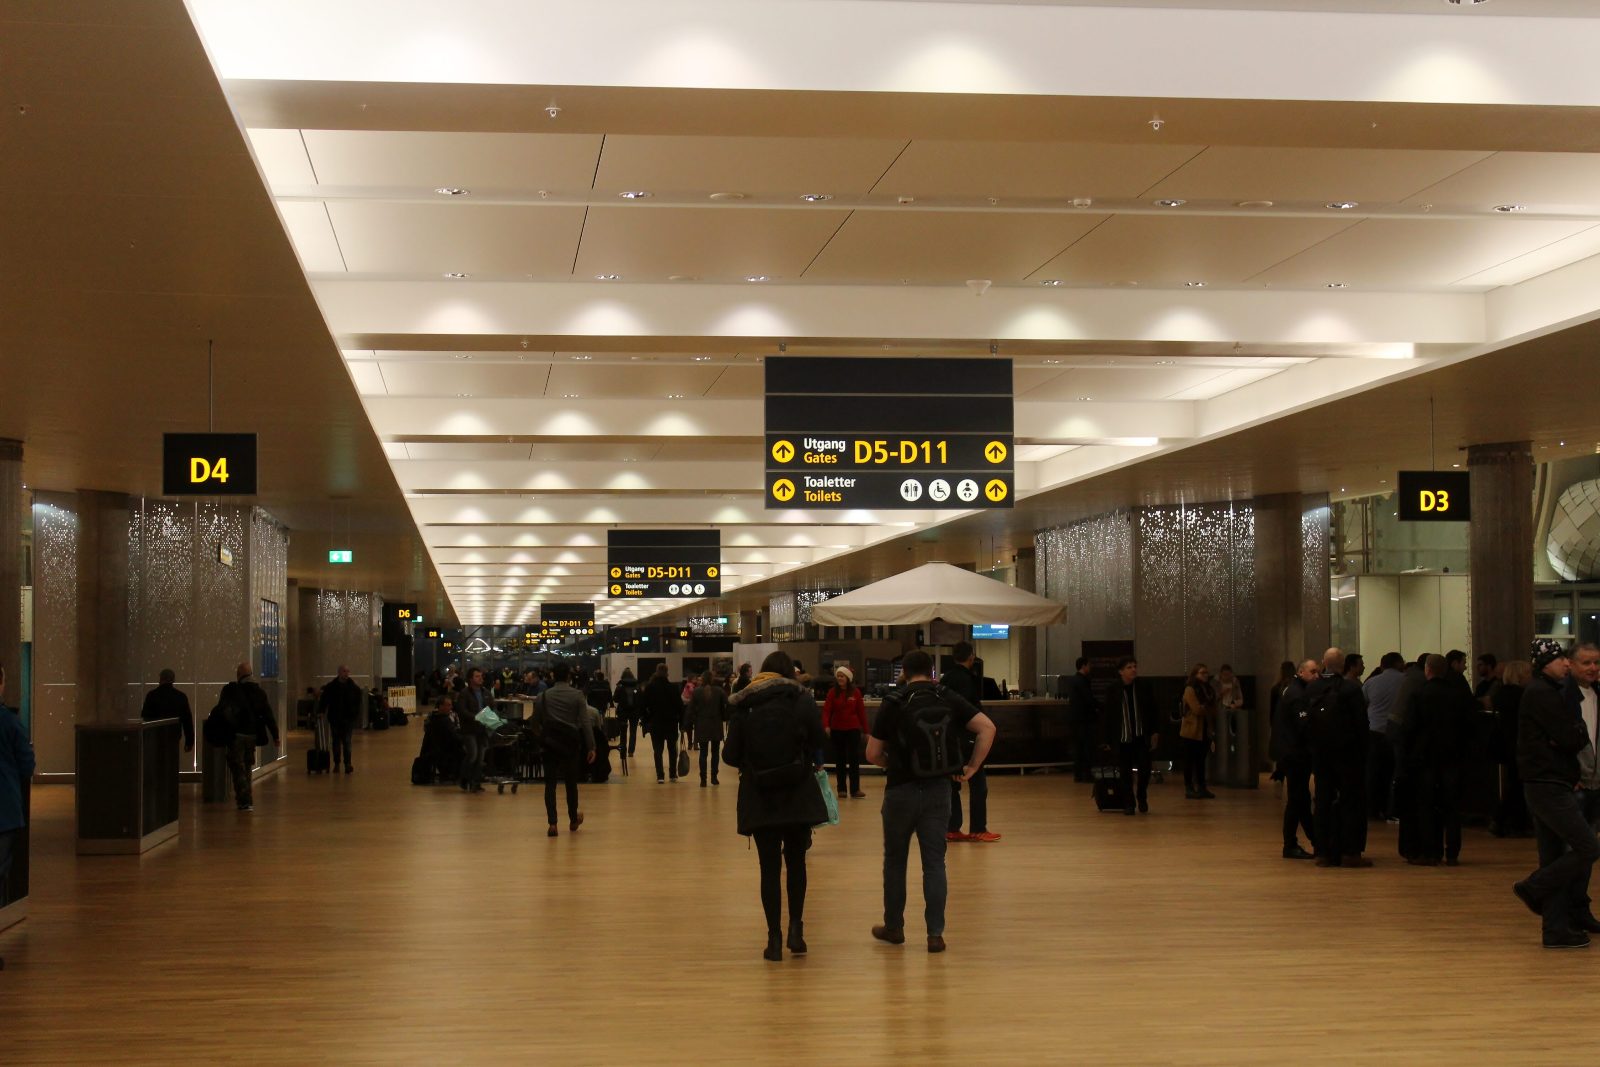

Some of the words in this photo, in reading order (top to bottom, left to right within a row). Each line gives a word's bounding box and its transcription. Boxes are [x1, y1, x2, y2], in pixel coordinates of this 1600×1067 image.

[803, 437, 846, 453] Utgang
[803, 452, 838, 464] Gates
[854, 440, 947, 464] D5-D11
[190, 457, 230, 483] D4
[803, 476, 856, 488] Toaletter
[803, 490, 842, 502] Toilets
[1420, 490, 1449, 511] D3
[647, 566, 691, 578] D5-D11
[398, 609, 411, 618] D6
